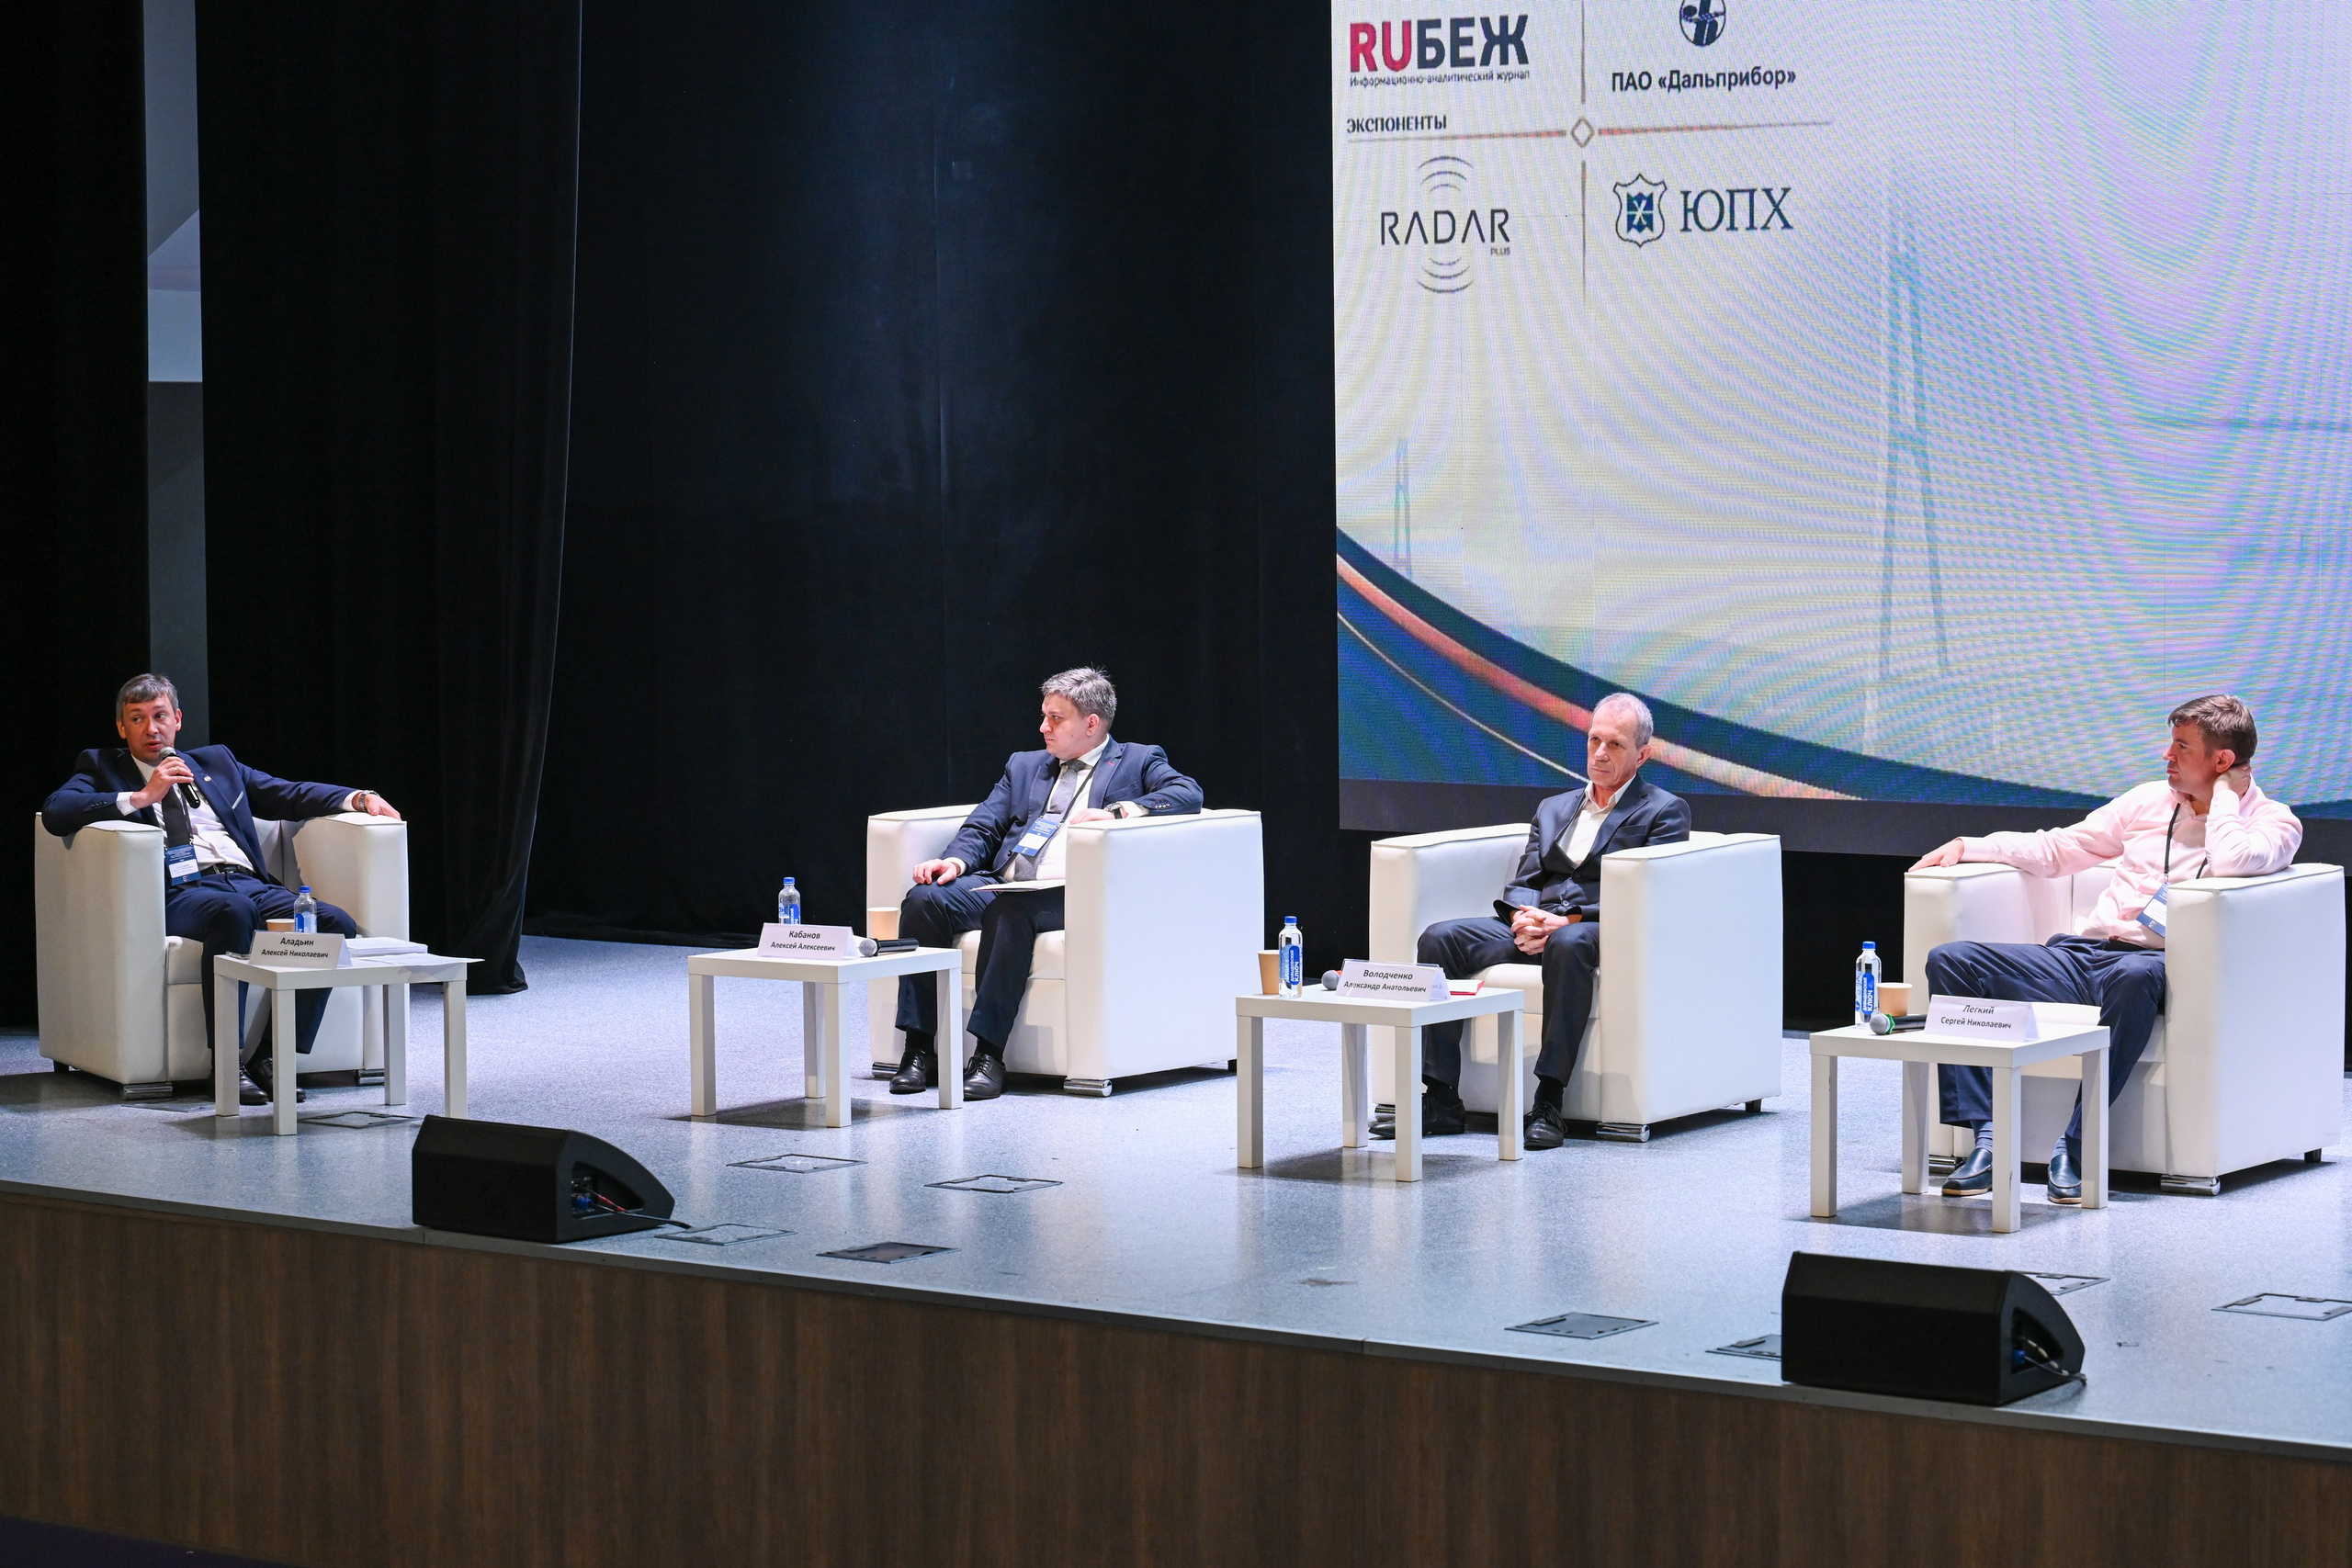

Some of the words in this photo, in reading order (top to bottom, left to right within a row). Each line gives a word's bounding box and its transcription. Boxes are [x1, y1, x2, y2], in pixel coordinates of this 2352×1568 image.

[1350, 15, 1530, 73] RUБЕЖ
[1350, 71, 1494, 89] Информационно-аналитический
[1496, 70, 1530, 83] журнал
[1611, 71, 1652, 91] ПАО
[1657, 66, 1796, 93] «Дальприбор»
[1347, 115, 1447, 133] ЭКСПОНЕНТЫ
[1679, 187, 1793, 232] ЮПХ
[1381, 209, 1510, 245] RADAR
[1490, 246, 1511, 255] PLUS
[279, 937, 314, 947] Аладьин
[788, 931, 820, 940] Кабанов
[770, 942, 797, 950] Алексей
[797, 942, 835, 952] Алексеевич
[288, 950, 329, 958] Николаевич
[1363, 969, 1413, 980] Володченко
[1343, 980, 1381, 991] Александр
[1381, 983, 1427, 993] Анатольевич
[1962, 1004, 1995, 1015] Легкий
[1940, 1016, 1965, 1026] Сергей
[1966, 1019, 2012, 1029] Николаевич
